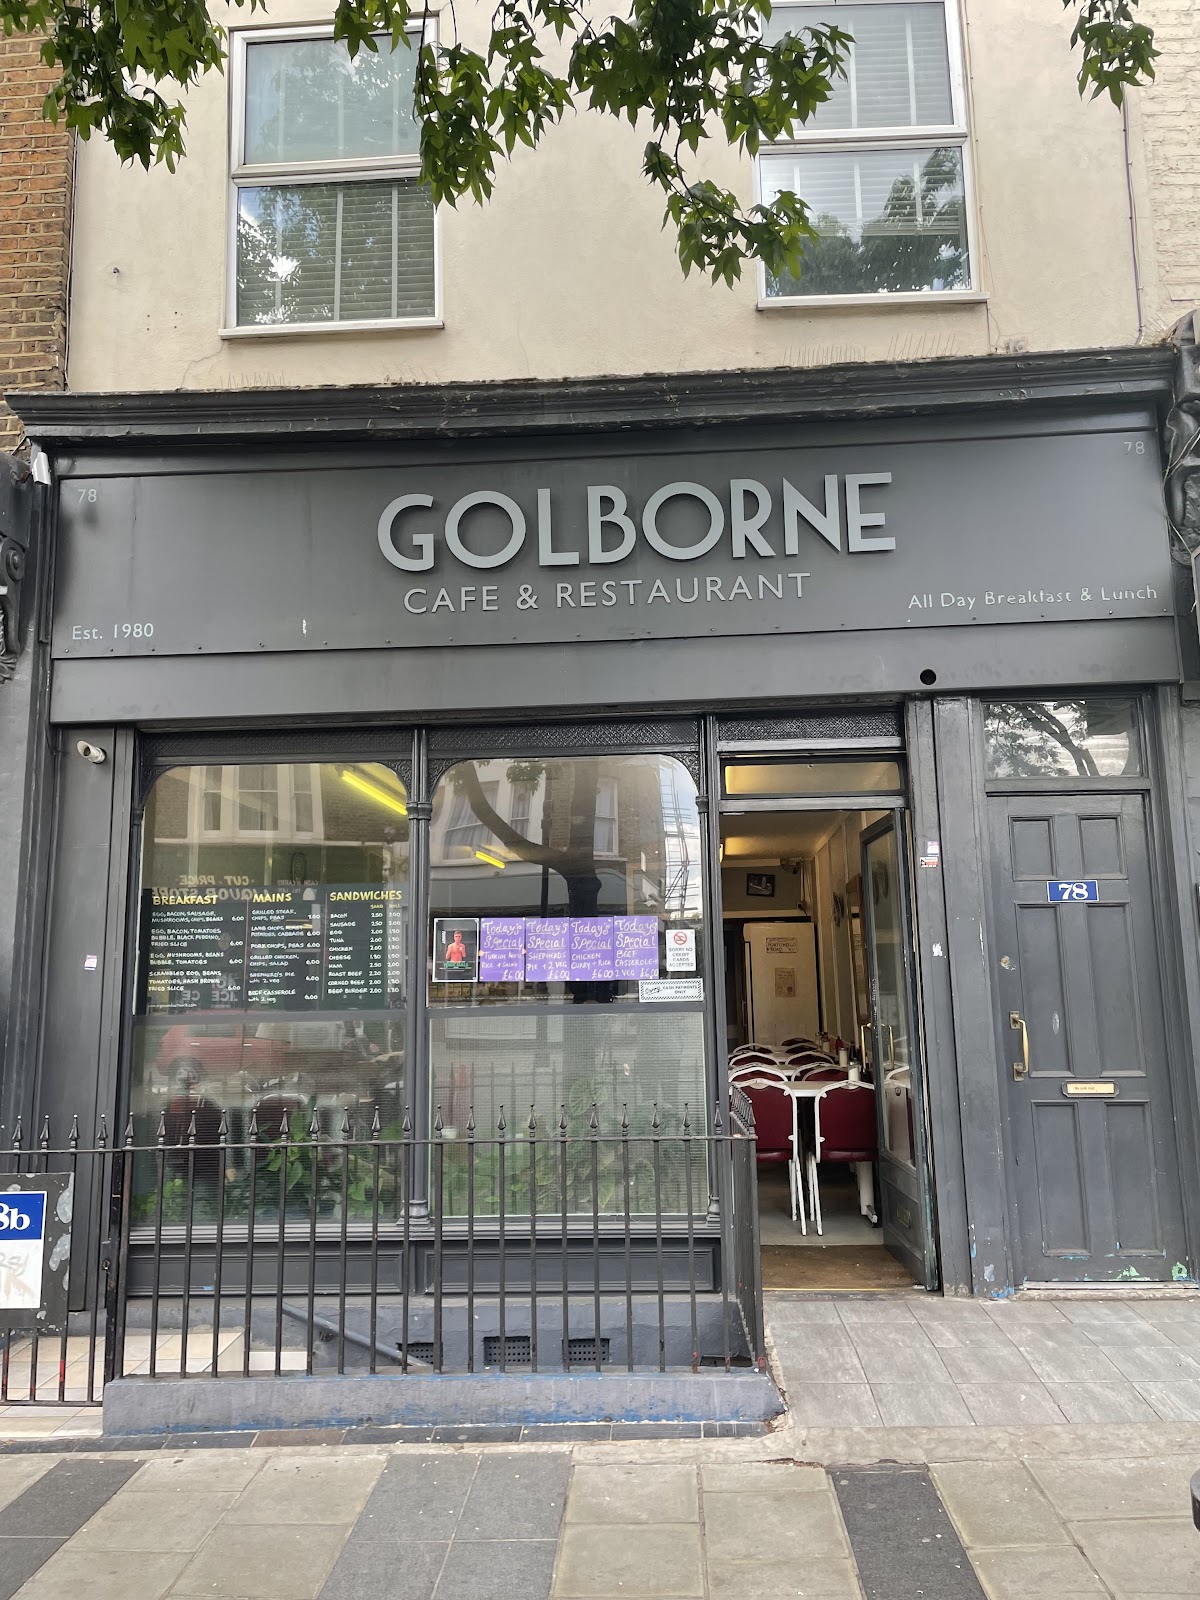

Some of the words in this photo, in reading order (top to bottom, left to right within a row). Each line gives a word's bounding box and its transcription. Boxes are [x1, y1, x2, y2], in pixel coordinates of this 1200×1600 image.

[1124, 440, 1144, 454] 78
[78, 489, 97, 502] 78
[377, 472, 897, 572] GOLBORNE
[404, 586, 499, 614] CAFE
[516, 584, 538, 610] &
[556, 572, 811, 608] RESTAURANT
[908, 593, 932, 609] All
[940, 592, 976, 610] Day
[985, 590, 1071, 606] Breakfast
[1080, 587, 1092, 601] &
[1101, 585, 1158, 601] Lunch
[72, 625, 103, 640] Est.
[114, 623, 154, 638] 1980
[252, 892, 292, 902] MAINS
[330, 890, 402, 901] SANDWICHES
[1058, 882, 1088, 900] 78
[152, 894, 218, 905] BREAKFAST
[482, 921, 522, 935] Today's
[527, 921, 568, 936] Today's
[571, 921, 610, 937] Today's
[615, 918, 658, 936] Today's
